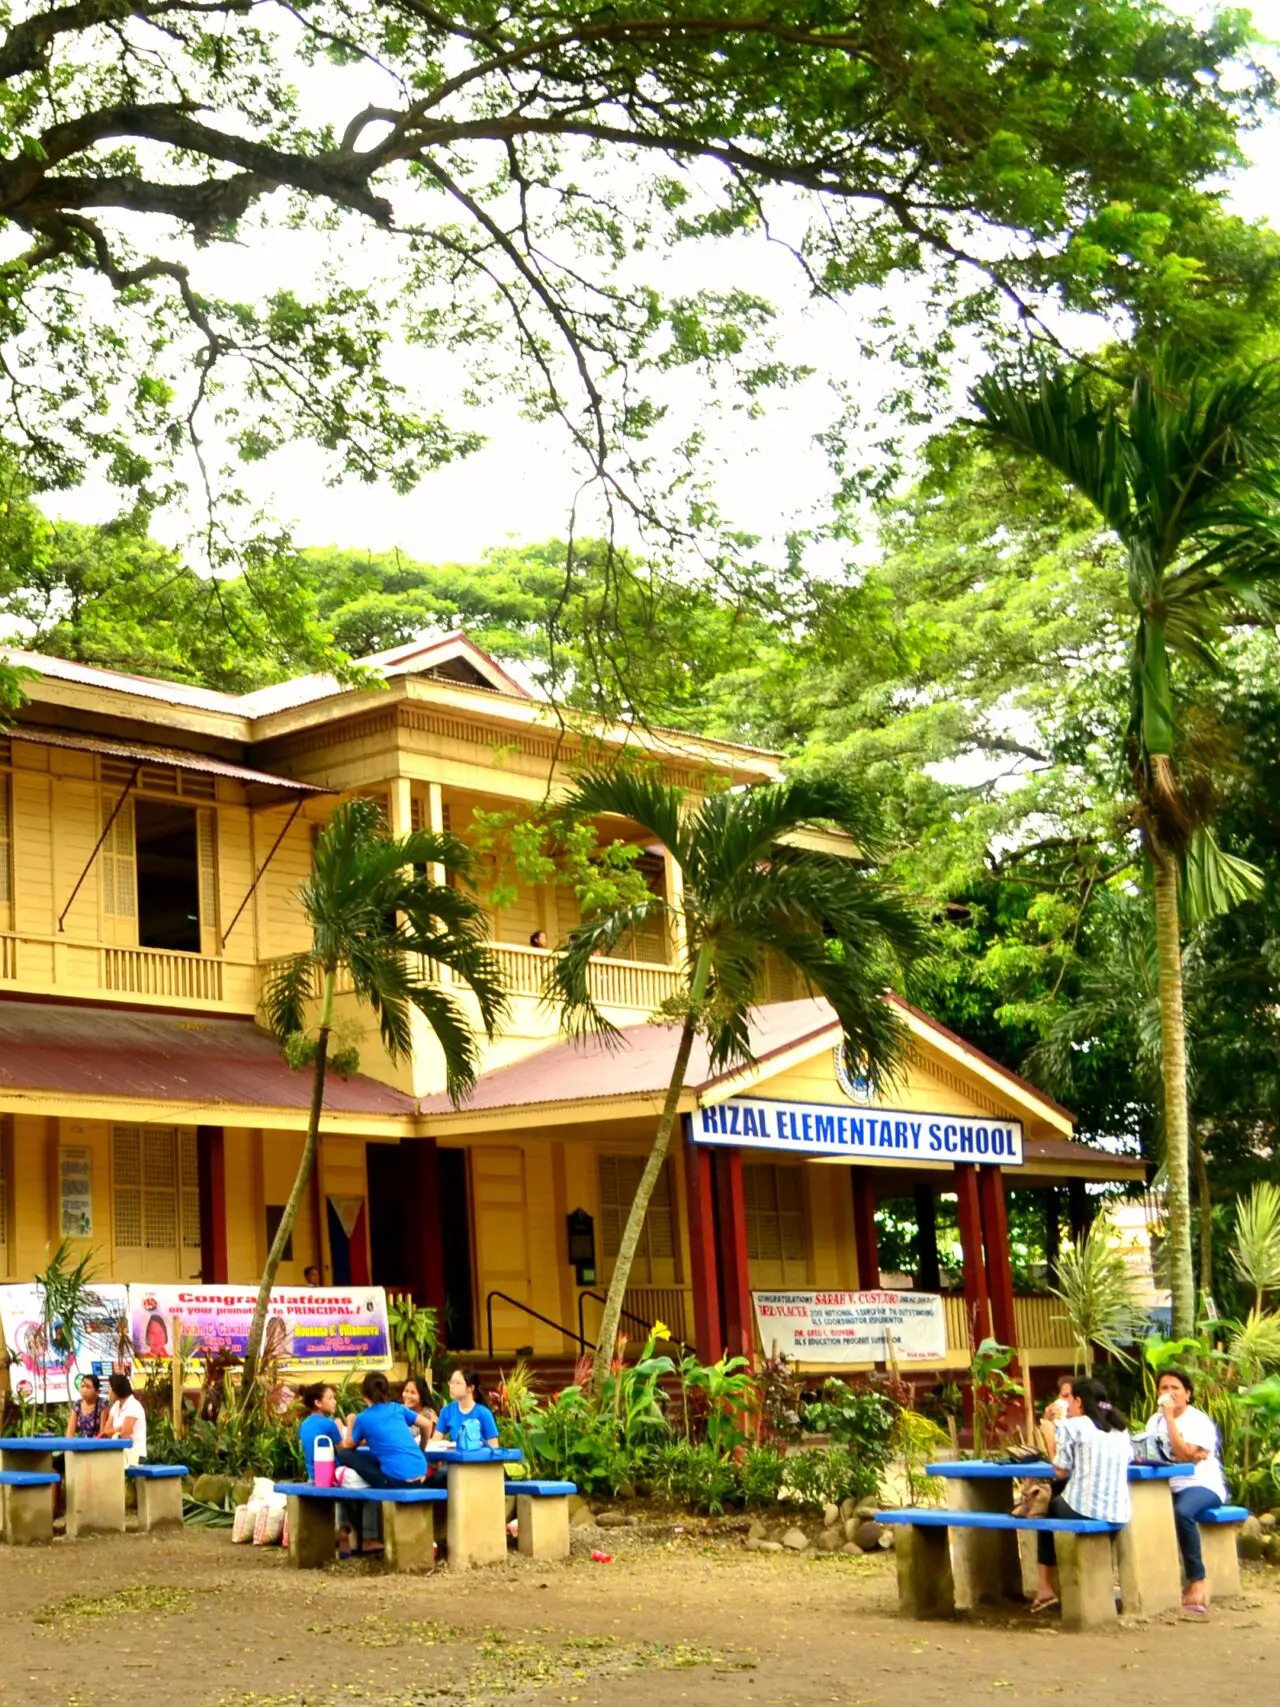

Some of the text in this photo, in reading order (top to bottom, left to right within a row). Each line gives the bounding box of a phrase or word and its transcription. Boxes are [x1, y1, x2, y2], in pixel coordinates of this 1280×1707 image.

[701, 1104, 1017, 1156] RIZAL ELEMENTARY SCHOOL
[178, 1293, 352, 1305] Congraulations
[169, 1307, 183, 1315] on
[187, 1307, 213, 1316] your
[287, 1306, 353, 1315] PRINCIPAL
